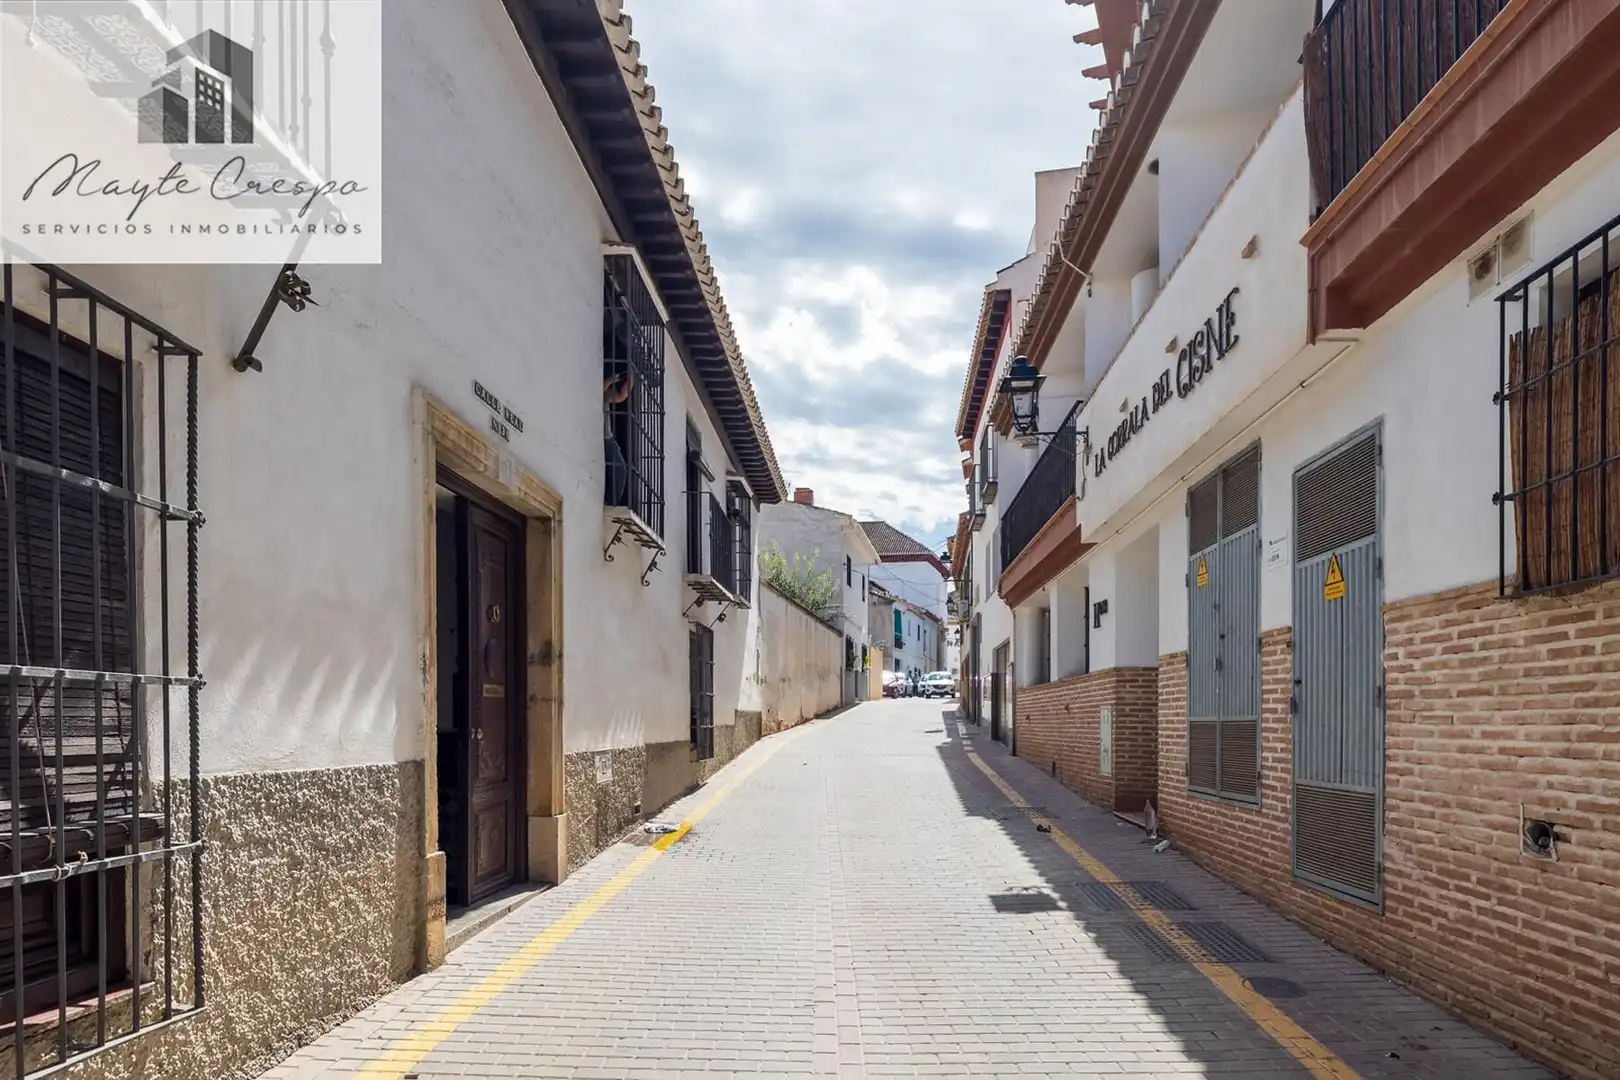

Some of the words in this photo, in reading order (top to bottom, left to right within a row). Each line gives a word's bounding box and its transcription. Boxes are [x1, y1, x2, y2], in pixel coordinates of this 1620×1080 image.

[1094, 447, 1107, 478] LA
[1107, 396, 1150, 461] CORRALA
[1151, 368, 1174, 414] DEL
[1176, 286, 1240, 399] CISNE
